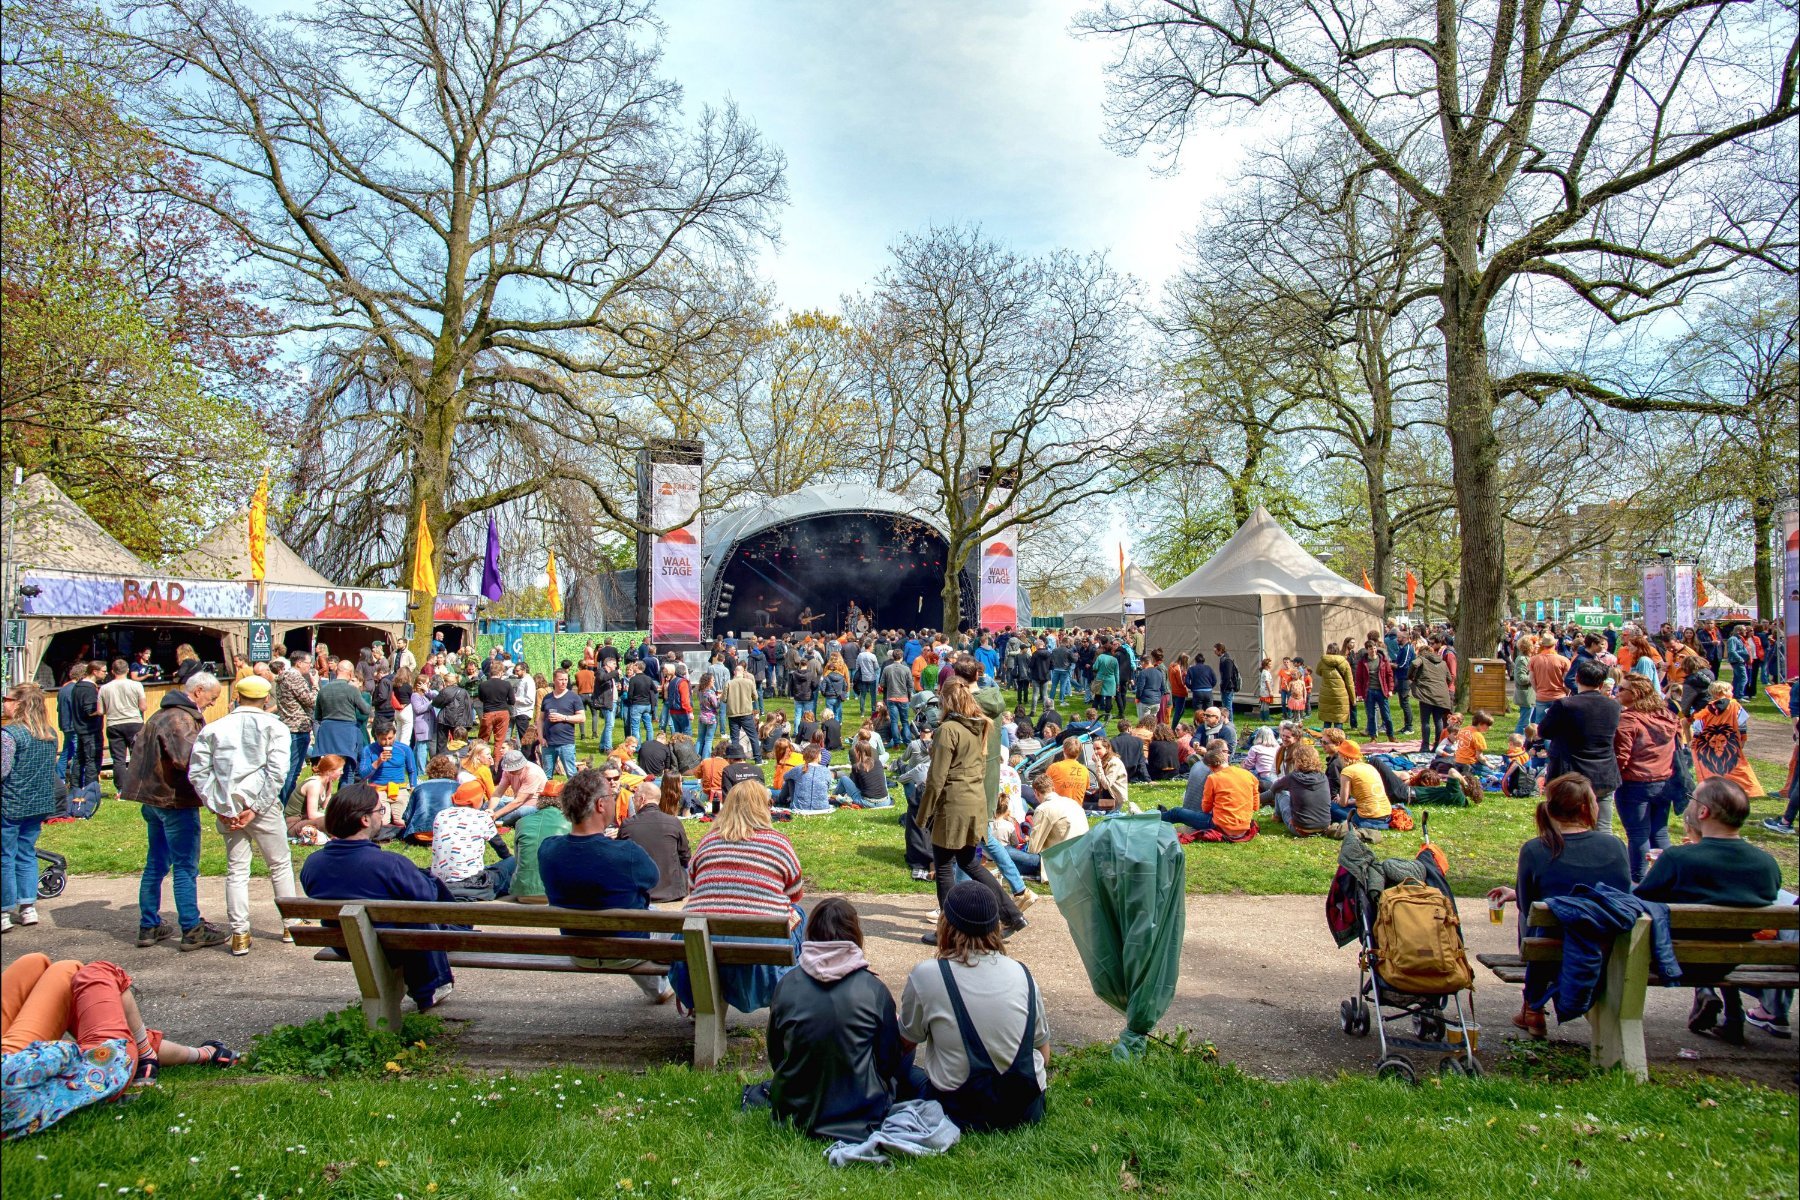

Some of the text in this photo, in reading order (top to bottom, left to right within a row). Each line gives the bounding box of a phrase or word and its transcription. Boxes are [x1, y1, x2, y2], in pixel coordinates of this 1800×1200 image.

[663, 556, 690, 566] WAAL
[661, 566, 692, 576] STAGE
[988, 567, 1008, 576] WAAL
[987, 575, 1010, 584] STAGE
[1584, 613, 1604, 624] EXIT
[1070, 766, 1082, 777] ZE
